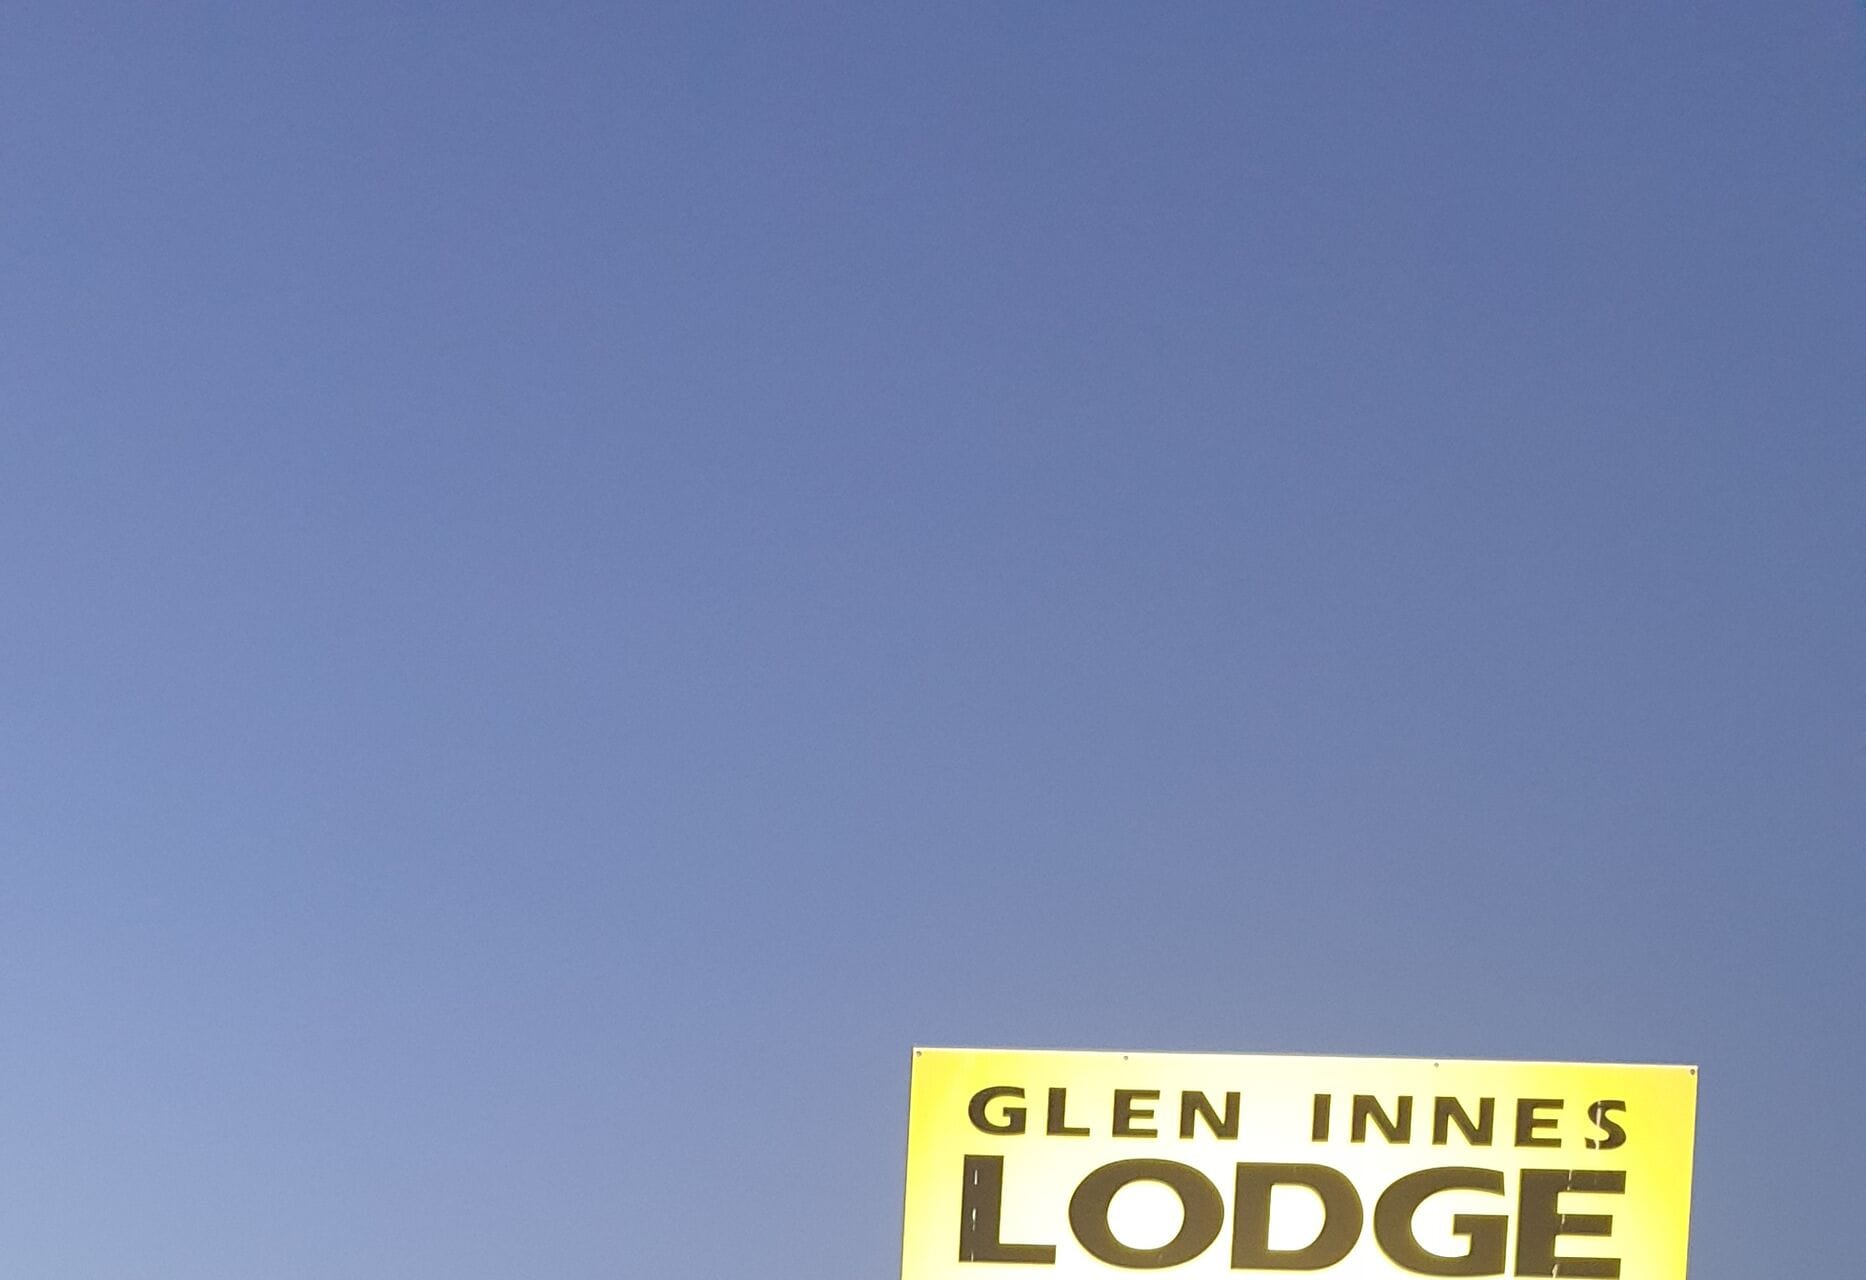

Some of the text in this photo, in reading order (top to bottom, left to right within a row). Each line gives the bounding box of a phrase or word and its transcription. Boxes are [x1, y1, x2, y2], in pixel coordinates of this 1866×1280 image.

[967, 1085, 1629, 1151] GLEN INNES
[957, 1153, 1628, 1280] LODGE
